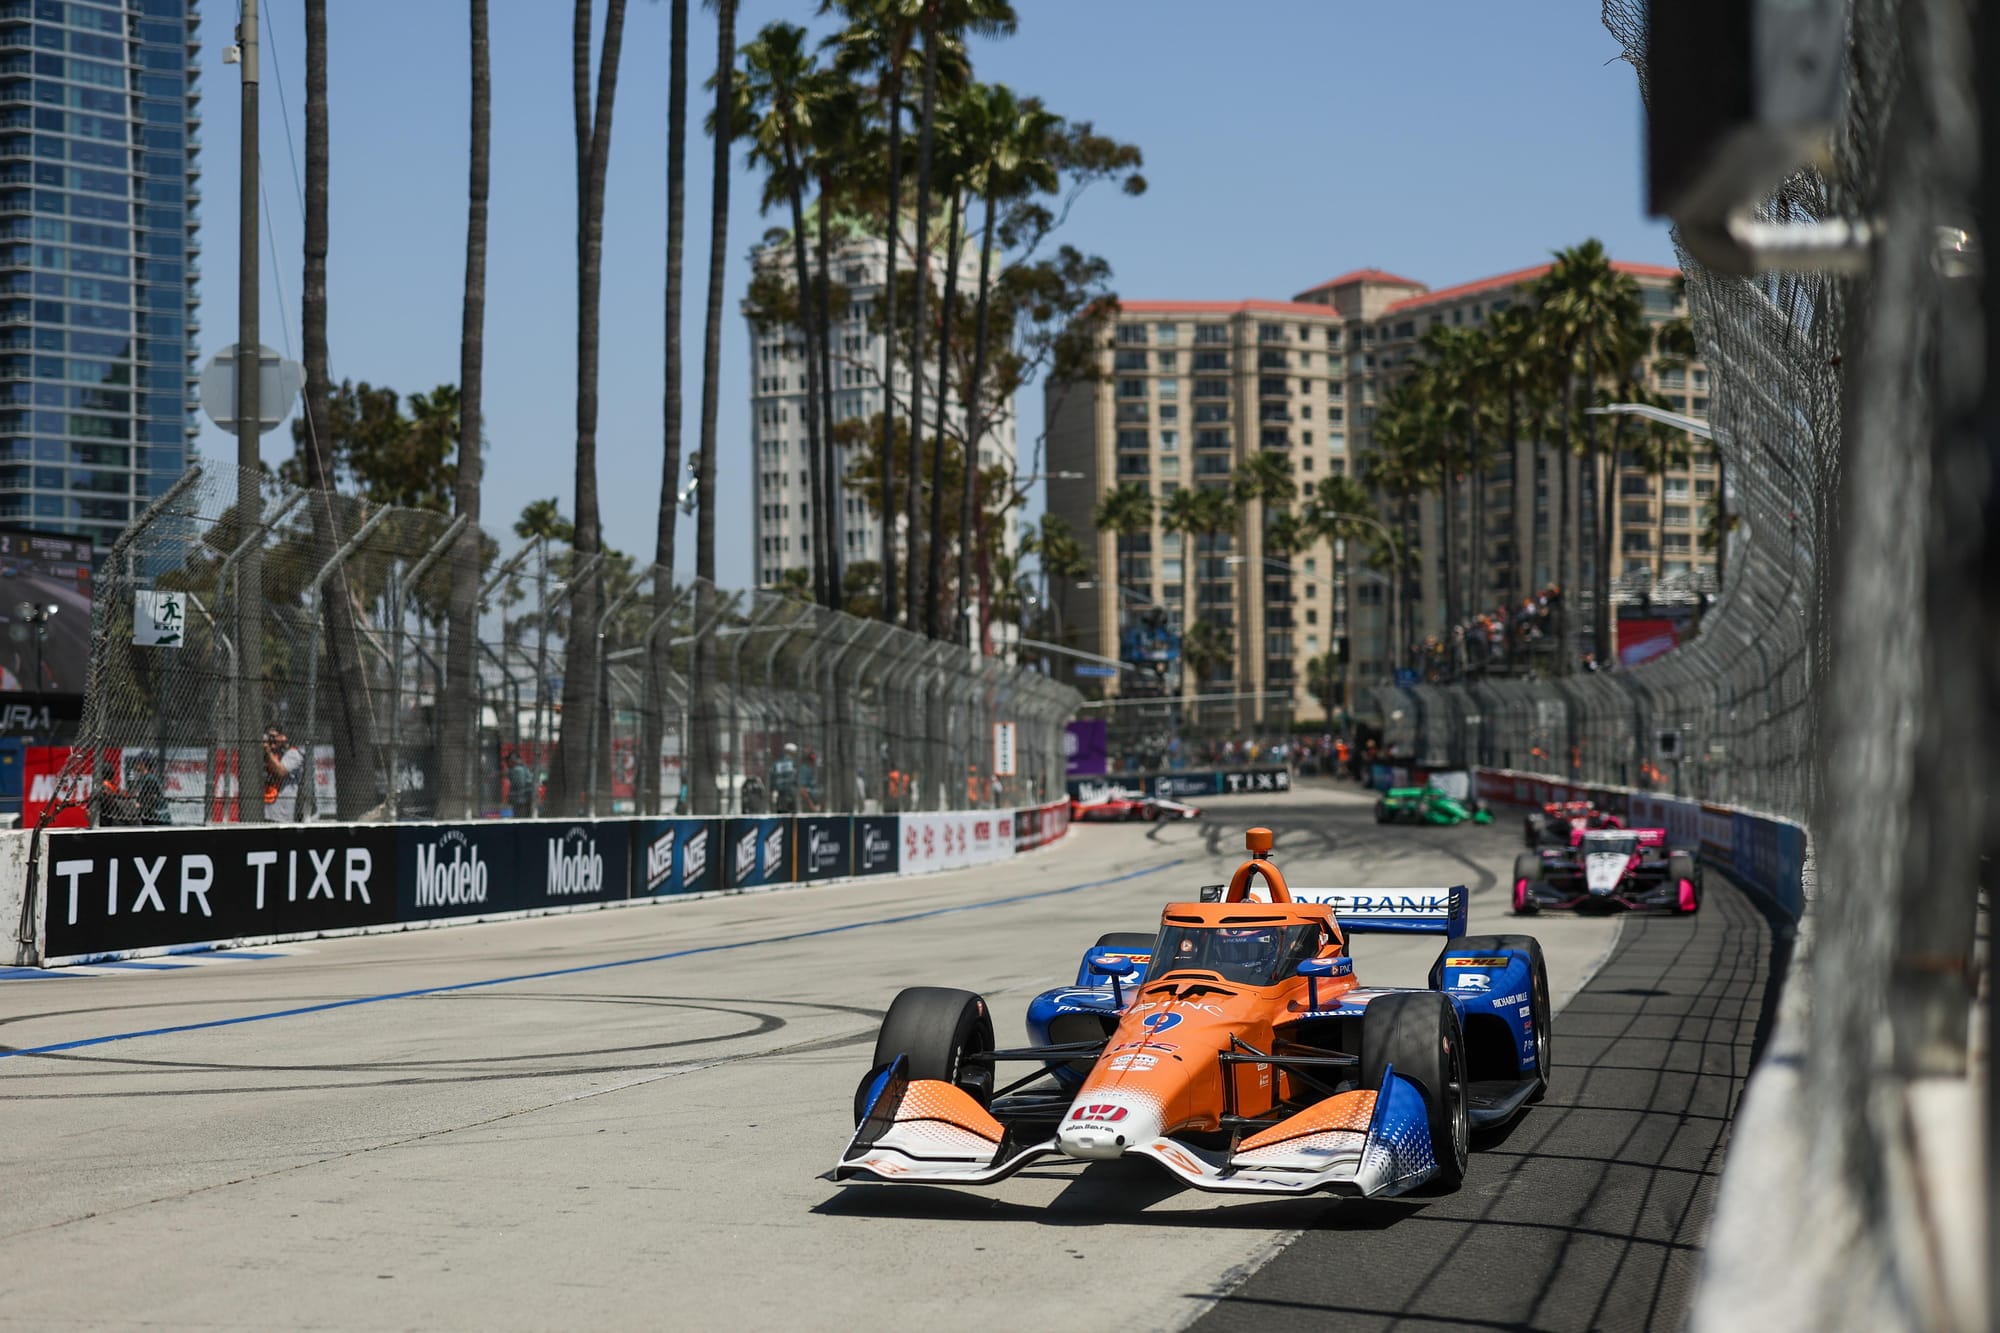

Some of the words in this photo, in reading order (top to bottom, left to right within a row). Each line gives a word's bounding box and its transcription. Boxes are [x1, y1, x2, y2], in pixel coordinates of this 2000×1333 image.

[1226, 772, 1290, 793] TIXR
[648, 829, 674, 882] NOS
[683, 829, 708, 878] NOS
[415, 843, 488, 907] Modelo
[547, 837, 604, 895] Modelo
[56, 854, 215, 926] TIXR
[246, 846, 372, 910] TIXR
[1351, 895, 1453, 913] BANK
[1340, 964, 1352, 973] PNC
[1457, 973, 1490, 988] R
[1162, 1000, 1223, 1017] PNC
[1141, 1011, 1184, 1035] 9
